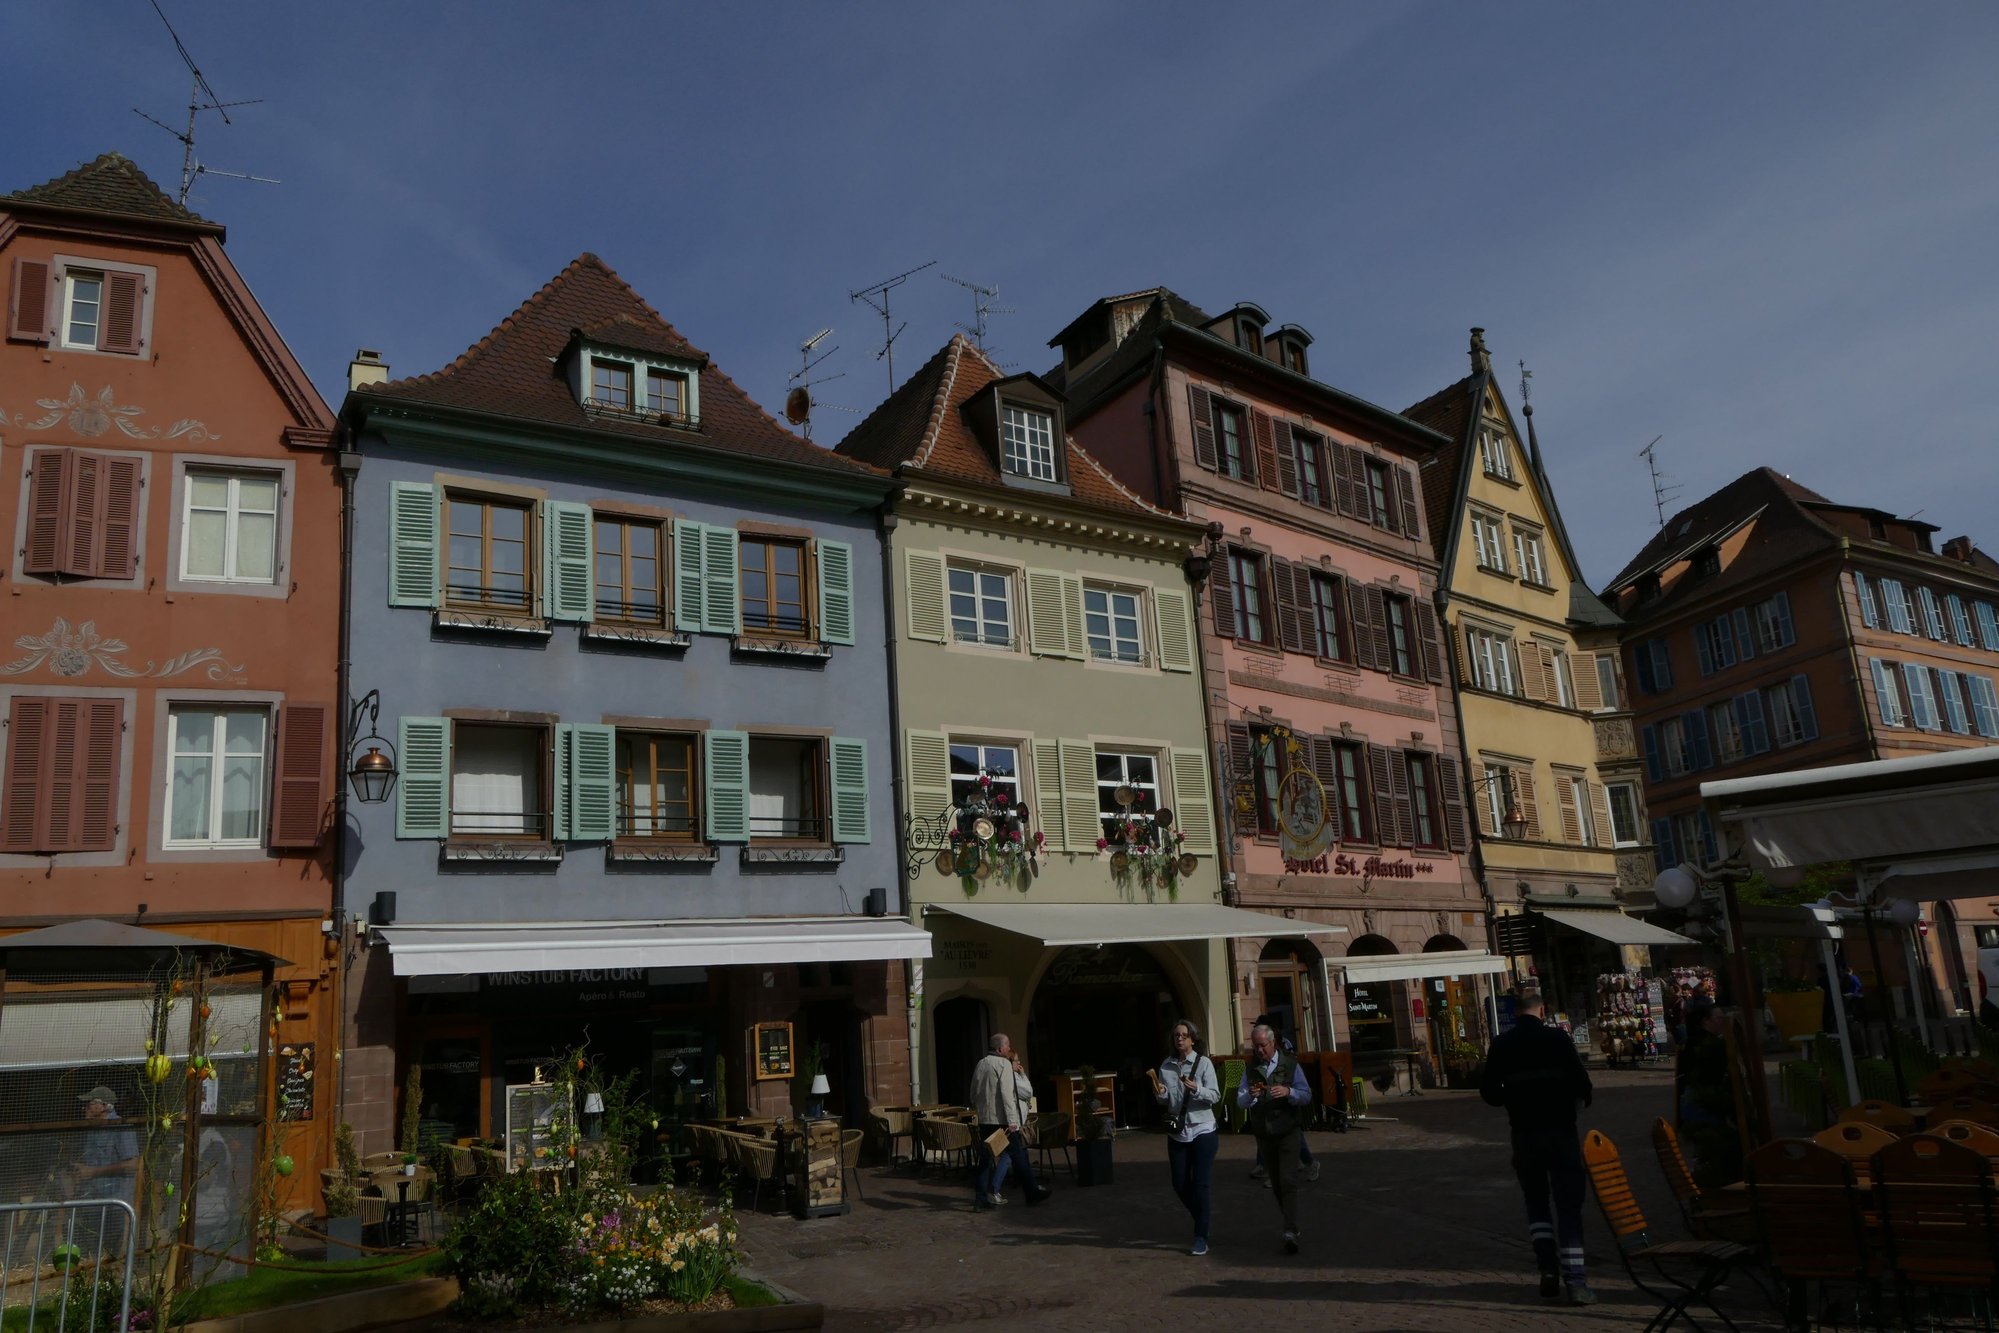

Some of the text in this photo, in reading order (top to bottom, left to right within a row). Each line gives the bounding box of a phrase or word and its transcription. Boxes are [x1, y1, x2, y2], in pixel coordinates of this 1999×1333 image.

[1334, 853, 1361, 876] St.
[1363, 856, 1414, 878] Martin
[487, 967, 645, 986] WINSTUB FACTORY
[449, 1060, 480, 1070] FACTORY
